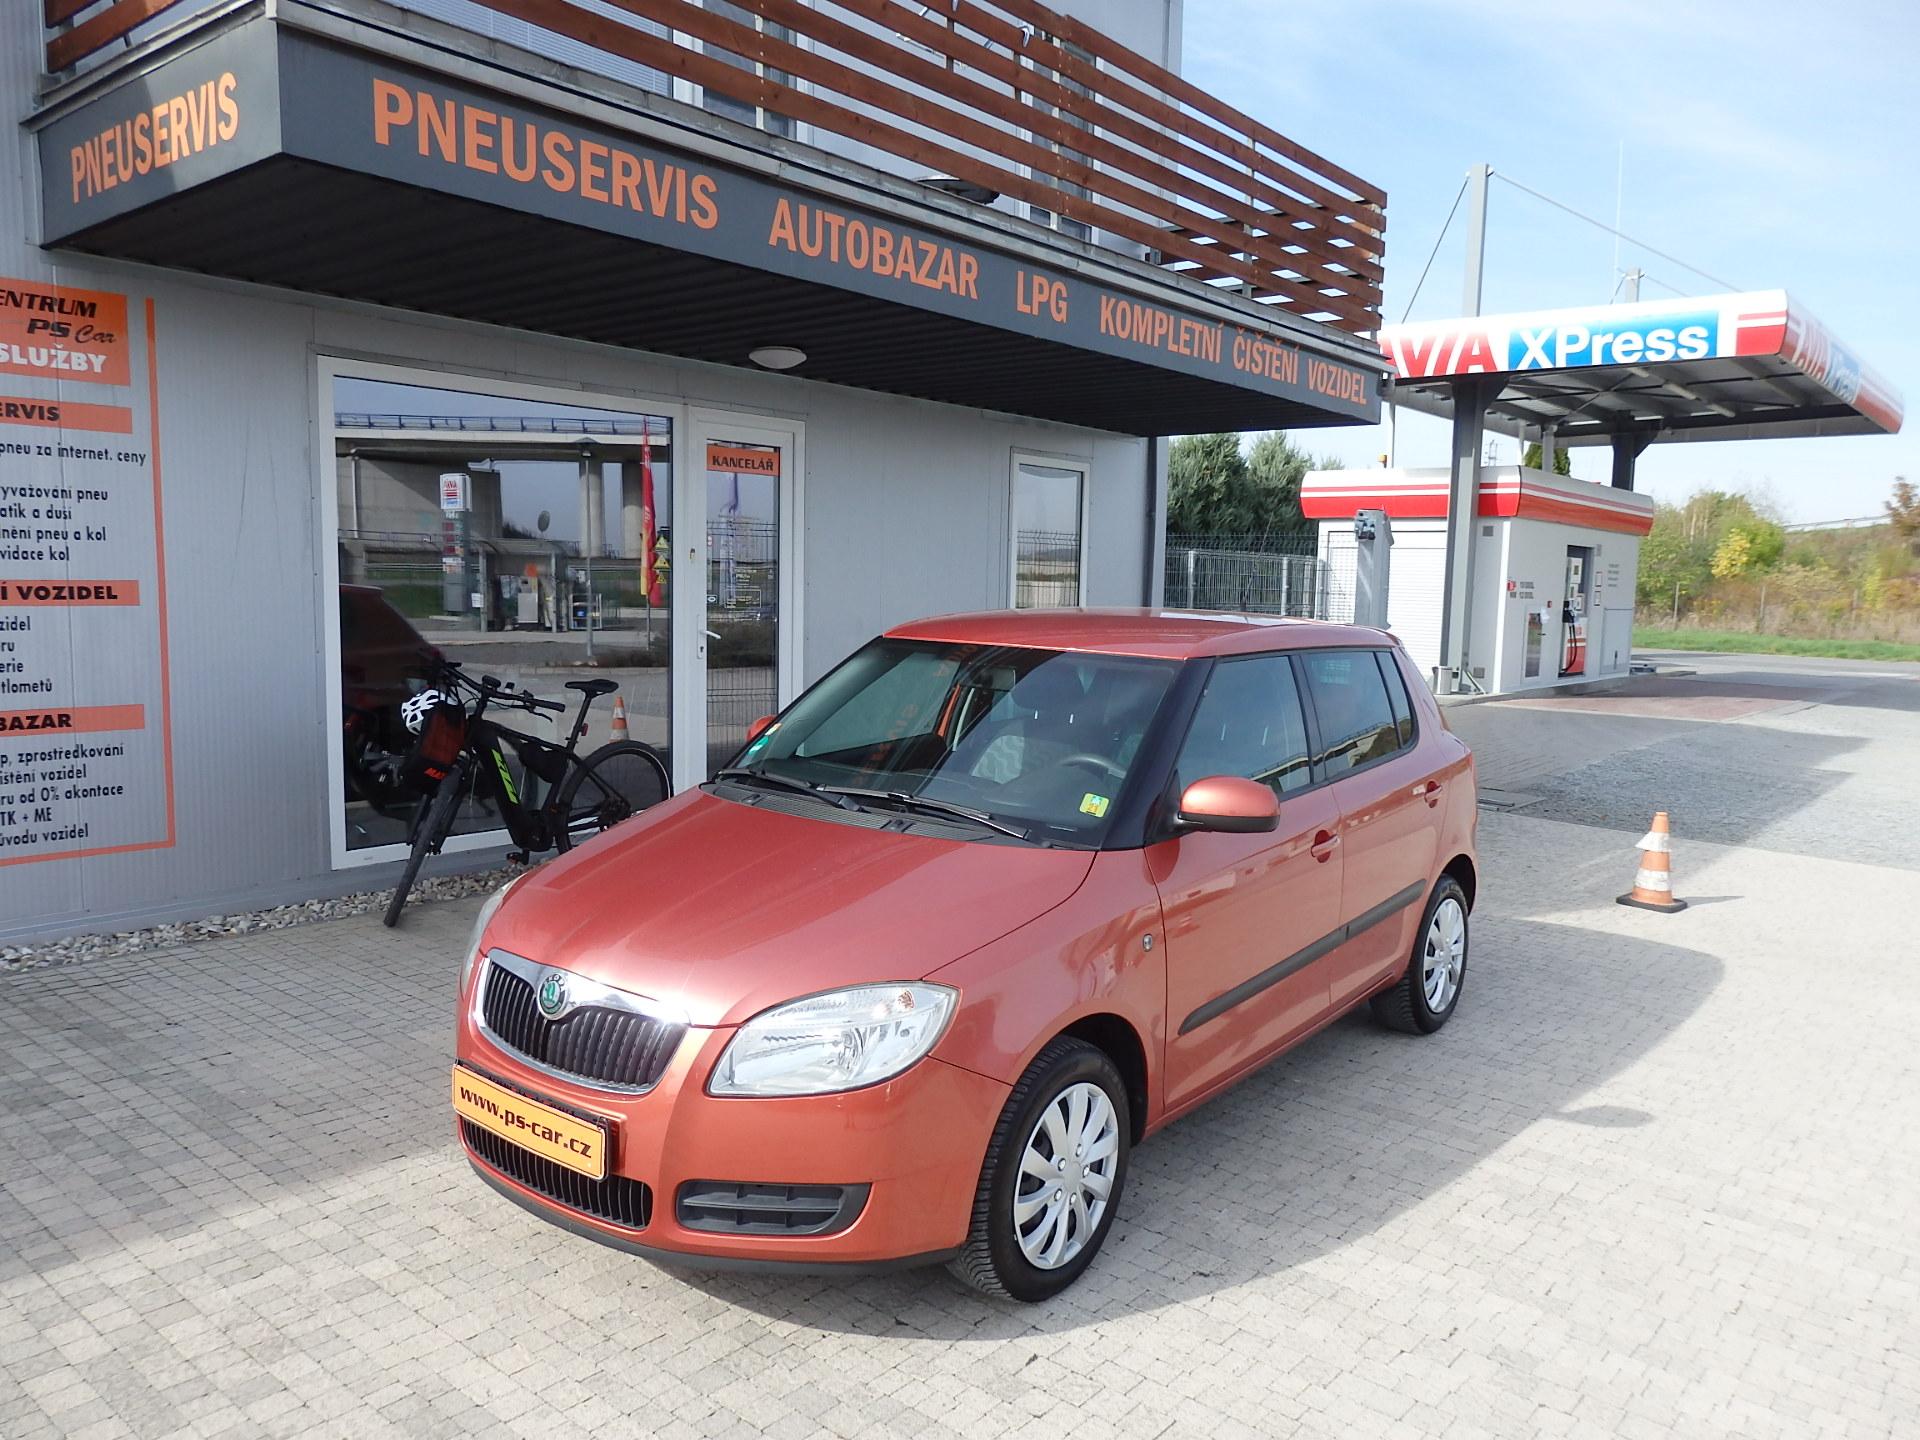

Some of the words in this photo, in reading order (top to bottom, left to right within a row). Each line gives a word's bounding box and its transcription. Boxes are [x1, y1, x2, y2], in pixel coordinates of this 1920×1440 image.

[71, 72, 239, 204] PNEUSERVIS
[372, 78, 719, 230] PNEUSERVIS
[768, 198, 978, 300] AUTOBAZAR
[1016, 271, 1068, 323] LPG
[1100, 294, 1222, 364] KOMPLETNÍ
[1233, 325, 1299, 385] ČIŠTĚNÍ
[1308, 358, 1367, 405] VOZIDEL
[27, 318, 72, 338] PS
[75, 324, 116, 343] Car
[1516, 326, 1709, 369] XPress
[0, 342, 107, 373] SLUŽBY
[0, 402, 60, 421] RVIS
[36, 445, 52, 457] za
[57, 442, 113, 462] internet.
[117, 451, 147, 467] ceny
[712, 455, 774, 471] KANCELÁŘ
[77, 489, 108, 503] pneu
[0, 503, 26, 519] atik
[32, 510, 41, 519] a
[46, 504, 72, 520] duší
[36, 527, 69, 543] pneu
[73, 530, 82, 540] a
[86, 525, 107, 541] kol
[0, 545, 44, 561] vidace
[49, 545, 70, 561] kol
[16, 585, 118, 600] VOZIDEL
[0, 615, 31, 631] zidel
[1, 641, 15, 652] ru
[0, 658, 24, 673] erie
[1, 678, 52, 693] tlometů
[0, 713, 72, 731] BAZAR
[17, 743, 124, 766] zprostředkování
[41, 763, 87, 781] vozidel
[1, 795, 14, 805] ru
[20, 788, 35, 804] od
[41, 786, 60, 802] 0%
[64, 784, 124, 800] akontace
[1, 810, 17, 826] TK
[34, 807, 52, 823] ME
[43, 822, 89, 841] vozidel
[460, 1086, 592, 1159] www.ps-car.cz
